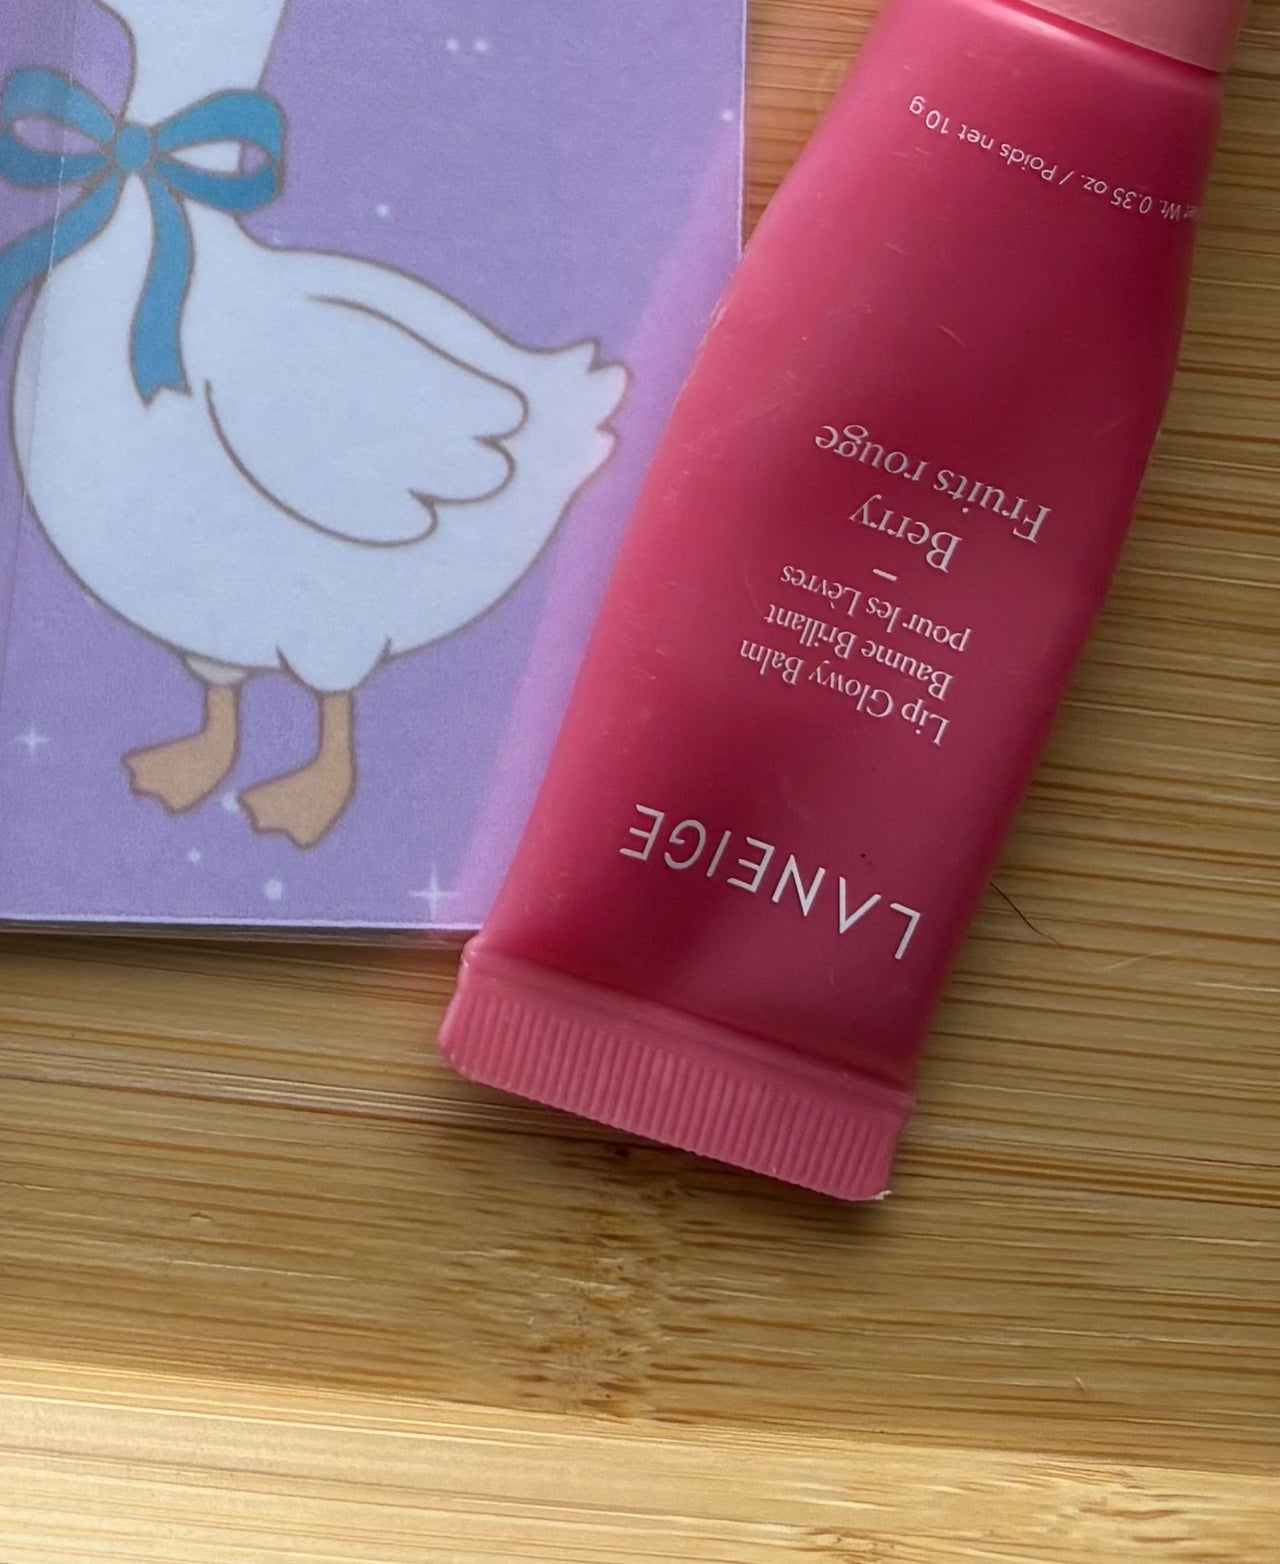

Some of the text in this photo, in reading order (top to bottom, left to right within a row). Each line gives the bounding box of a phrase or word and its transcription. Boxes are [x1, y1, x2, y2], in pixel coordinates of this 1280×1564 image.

[909, 95, 926, 116] g
[925, 109, 951, 135] 10
[958, 123, 994, 151] net
[999, 142, 1058, 182] Poids
[1080, 174, 1108, 195] oz.
[1112, 186, 1152, 214] 0.35
[815, 423, 1052, 544] Fruits rouge
[848, 494, 963, 574] Berry
[779, 564, 972, 653] pour les Lèvres
[763, 603, 954, 701] Baume Brillant
[739, 638, 951, 746] Lip Glowy Balm
[619, 803, 921, 960] LANEIGE
